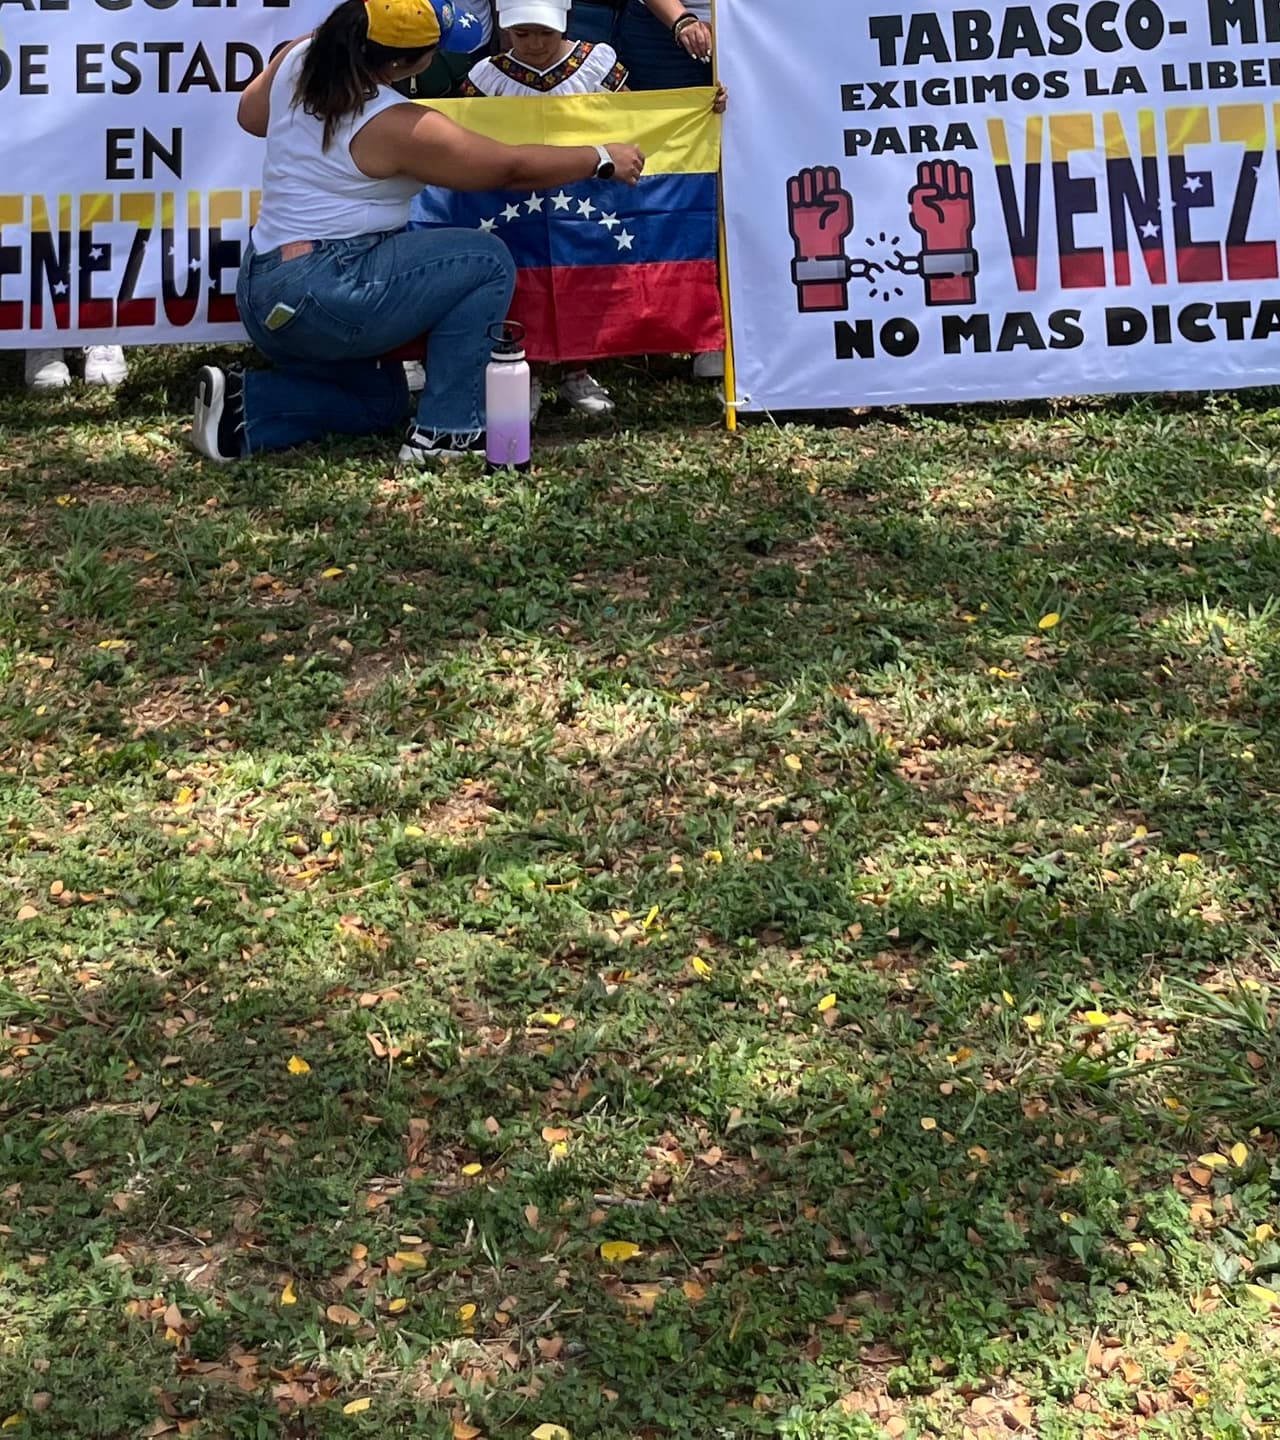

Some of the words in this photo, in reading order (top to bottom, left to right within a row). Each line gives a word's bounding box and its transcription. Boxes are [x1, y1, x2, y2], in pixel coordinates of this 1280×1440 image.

[840, 70, 1070, 112] EXIGIMOS
[1084, 66, 1148, 97] LA
[105, 126, 183, 181] EN
[843, 122, 979, 157] PARA
[833, 317, 920, 360] NO
[941, 309, 1085, 355] MAS
